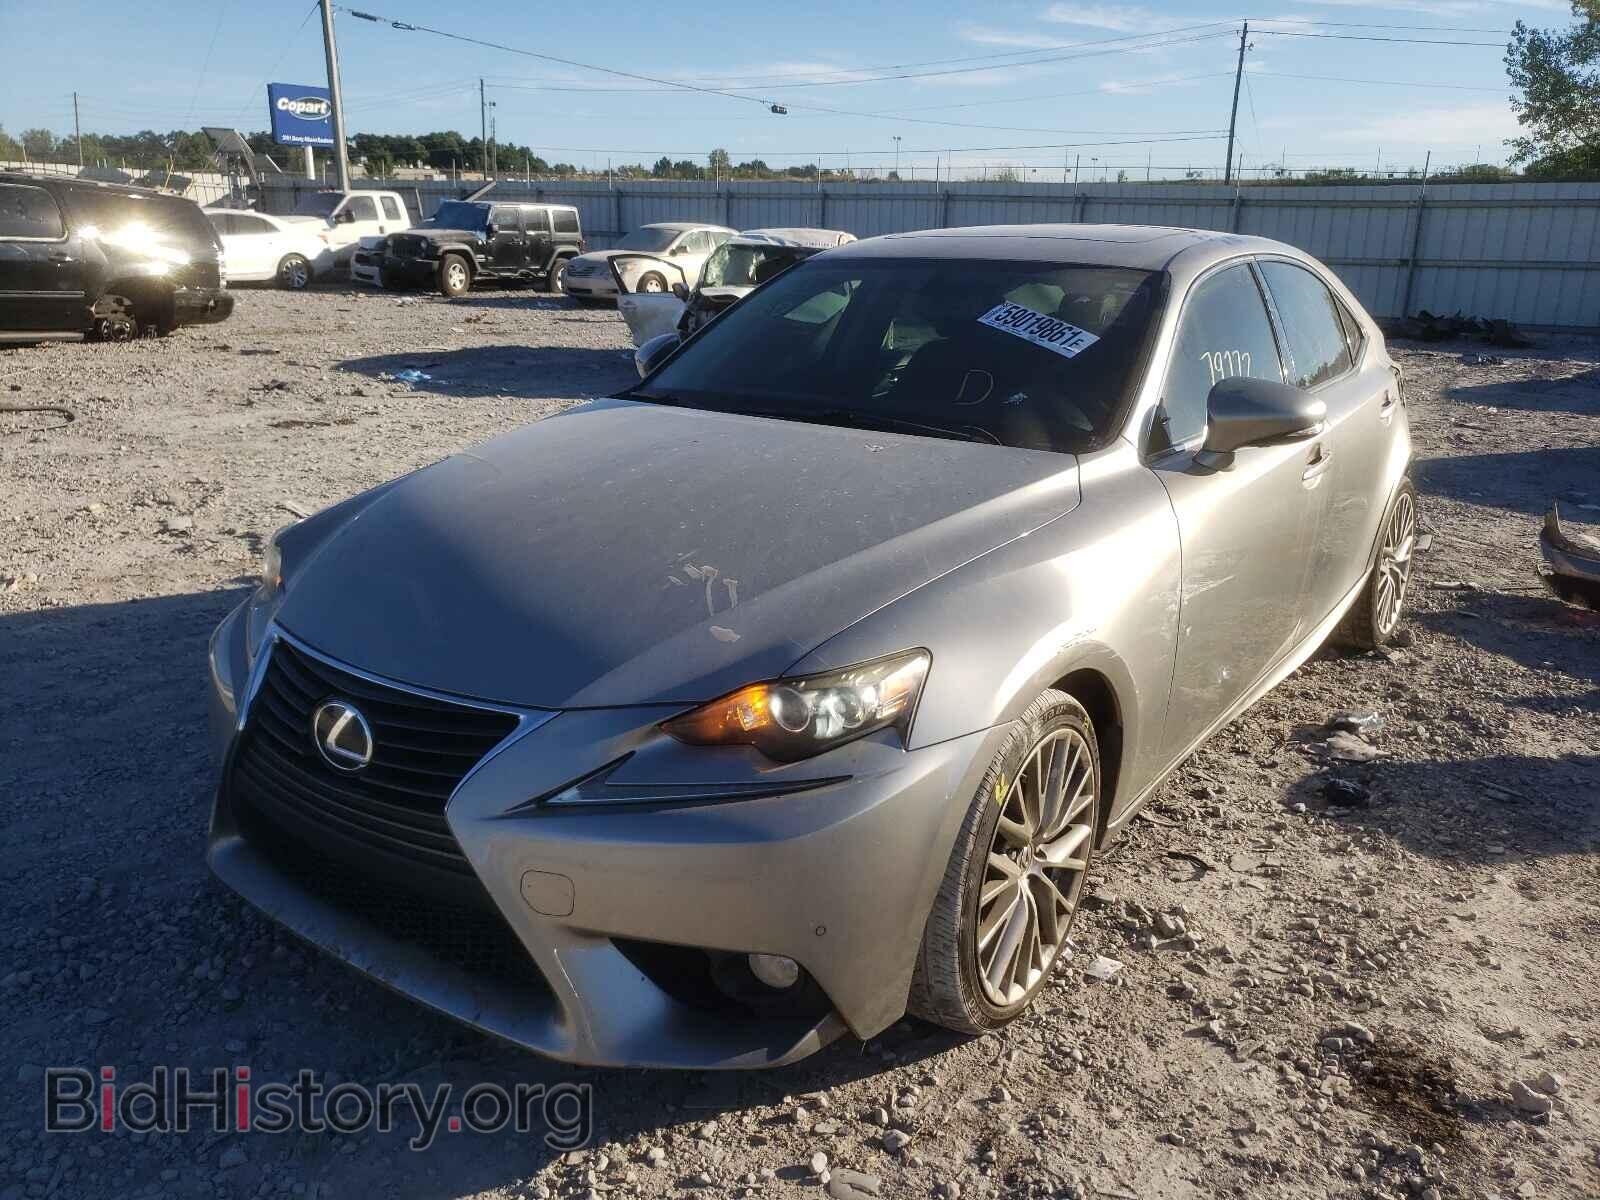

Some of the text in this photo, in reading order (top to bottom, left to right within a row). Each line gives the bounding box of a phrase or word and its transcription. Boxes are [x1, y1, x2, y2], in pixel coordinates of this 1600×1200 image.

[277, 97, 327, 114] Copart
[995, 305, 1082, 347] 59019861
[953, 369, 994, 405] D
